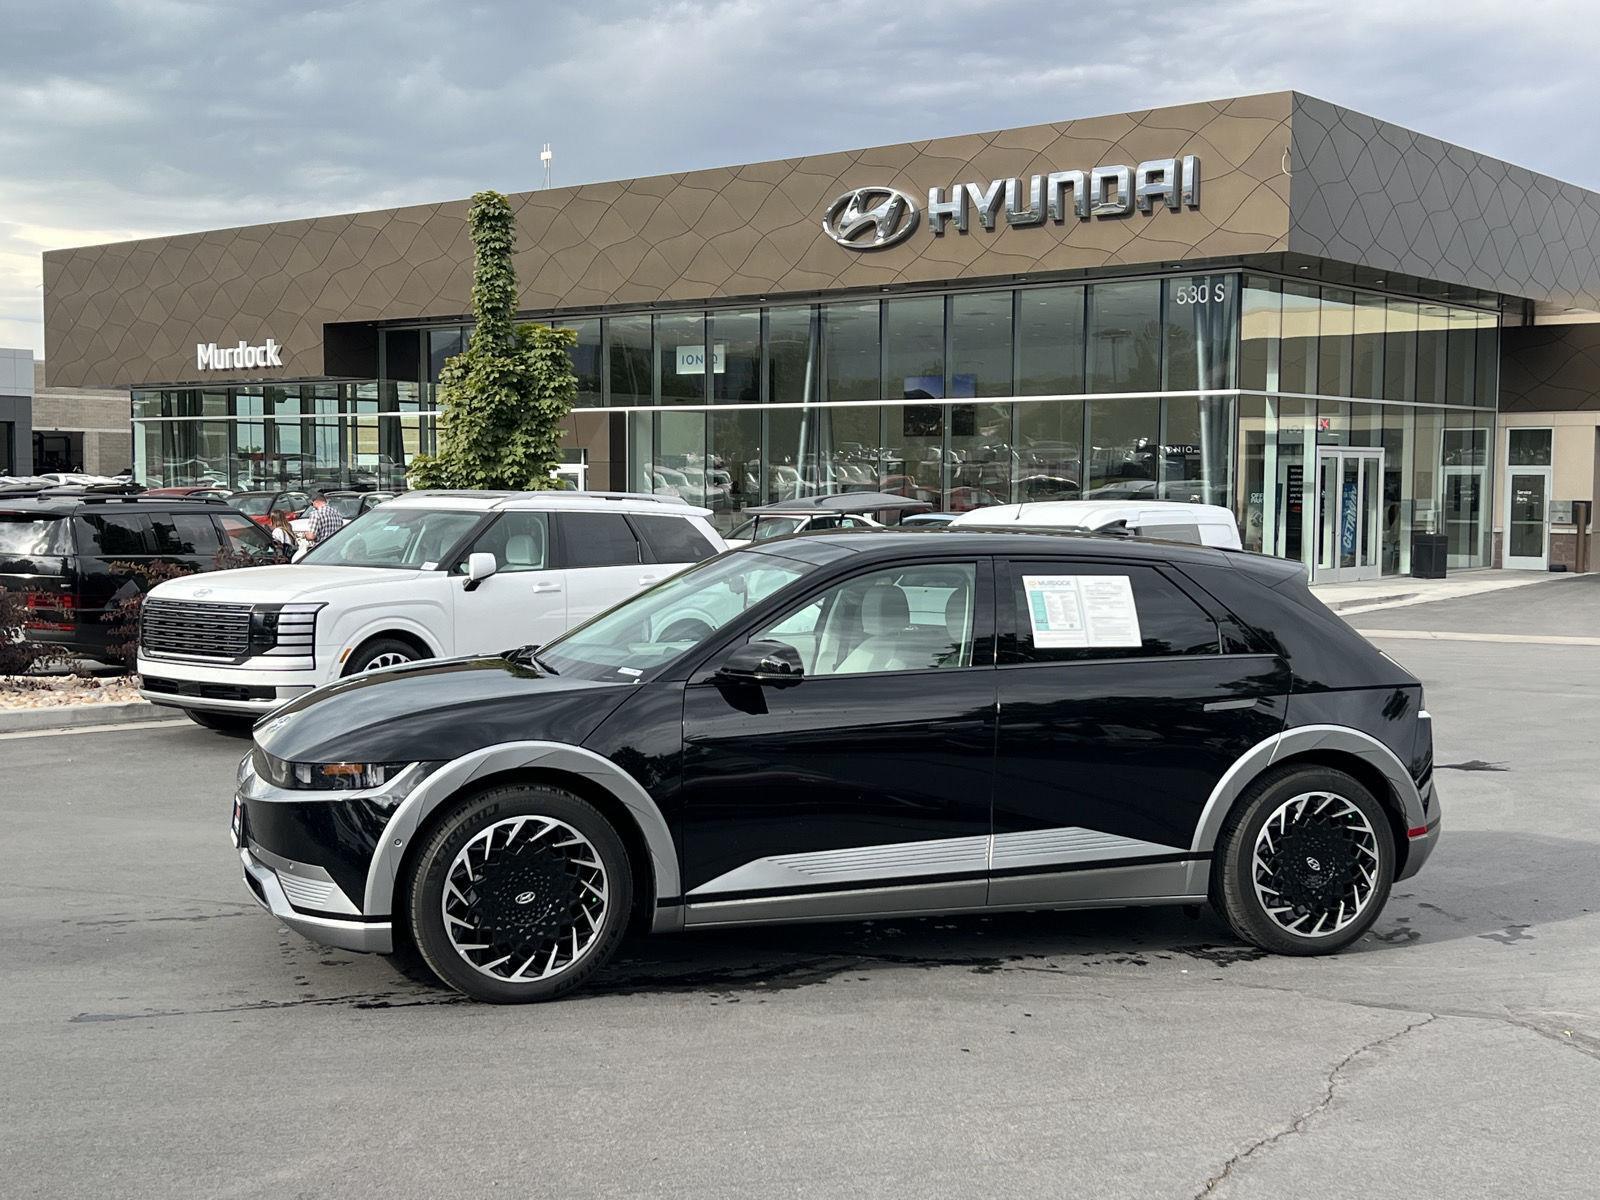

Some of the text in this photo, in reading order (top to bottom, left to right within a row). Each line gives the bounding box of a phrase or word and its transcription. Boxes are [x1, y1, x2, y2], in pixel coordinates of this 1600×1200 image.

[928, 155, 1200, 236] HYUNDAI
[1176, 283, 1225, 305] 530 S
[197, 338, 283, 371] Murdock
[681, 354, 718, 365] IONQ
